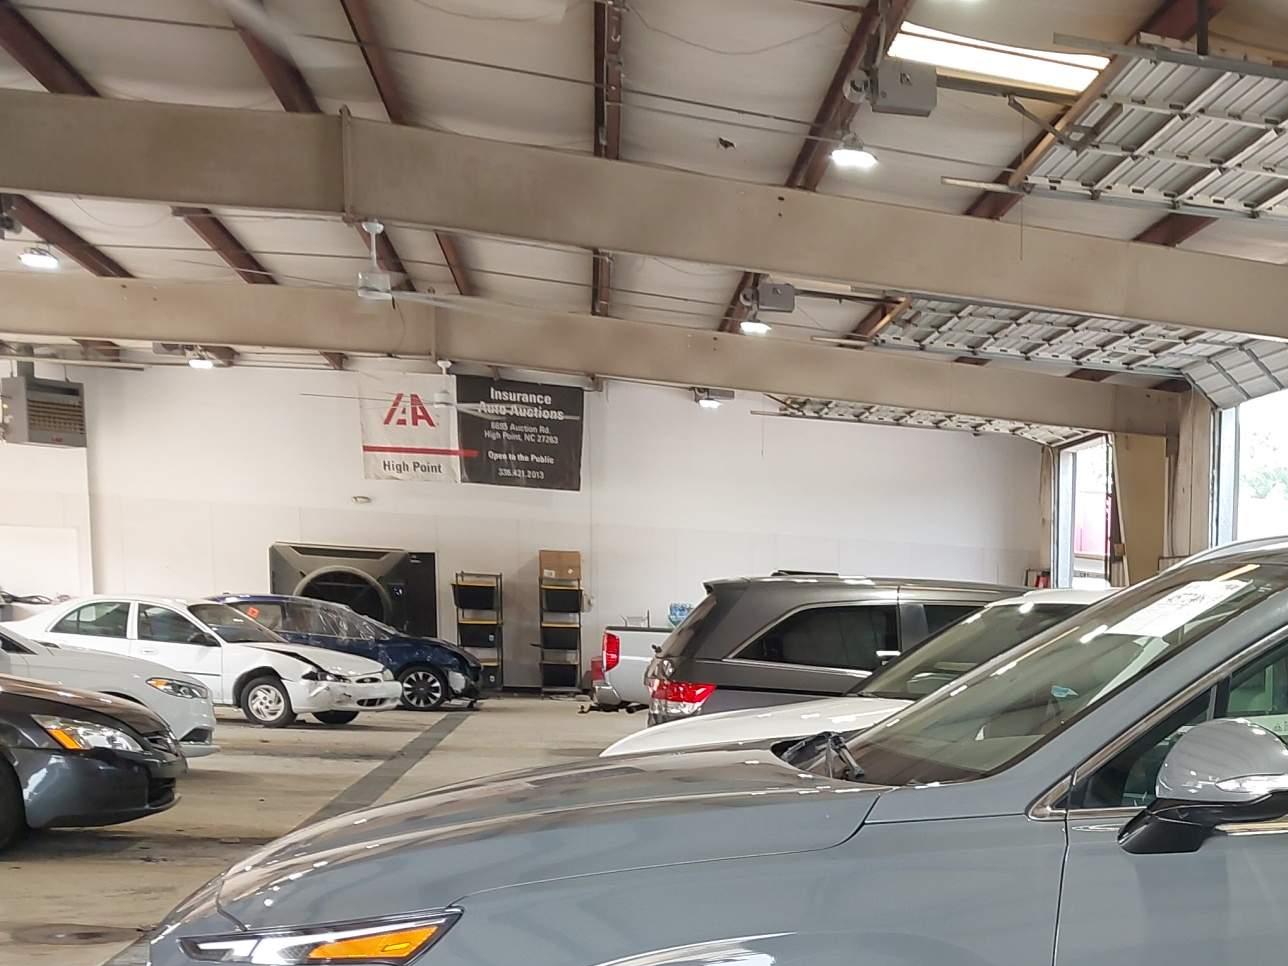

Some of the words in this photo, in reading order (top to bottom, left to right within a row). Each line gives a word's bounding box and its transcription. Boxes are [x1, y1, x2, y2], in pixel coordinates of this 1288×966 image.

[490, 386, 552, 405] Insurance
[478, 401, 508, 416] Auto
[510, 404, 565, 421] Auctions
[510, 423, 538, 433] Auction
[484, 430, 501, 441] High
[524, 433, 536, 443] NC
[487, 450, 507, 461] Open
[517, 453, 529, 462] the
[531, 454, 555, 464] Public
[382, 460, 409, 474] High
[412, 461, 443, 474] Point
